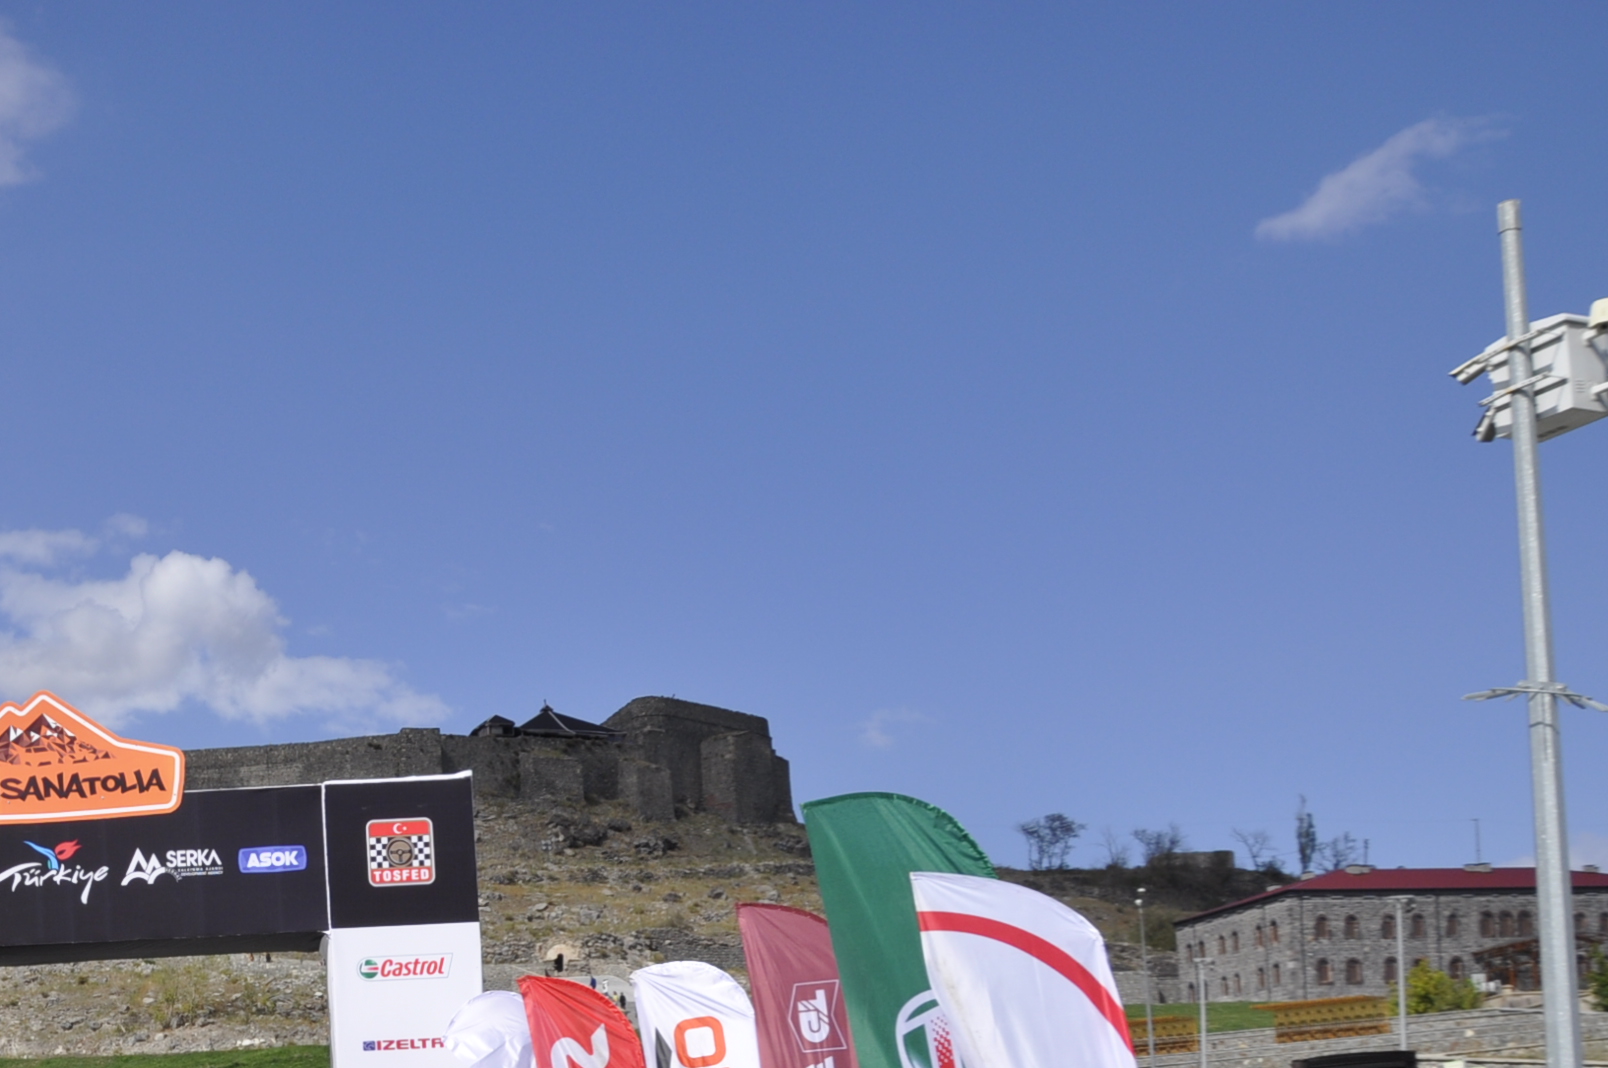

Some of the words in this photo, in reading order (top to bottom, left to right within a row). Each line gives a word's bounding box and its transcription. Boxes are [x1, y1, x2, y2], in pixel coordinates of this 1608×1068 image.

[165, 848, 222, 867] SERKA
[246, 849, 299, 868] ASOK
[373, 866, 430, 882] TOSFED
[380, 957, 445, 977] Castrol
[377, 1037, 445, 1051] IZELTA
